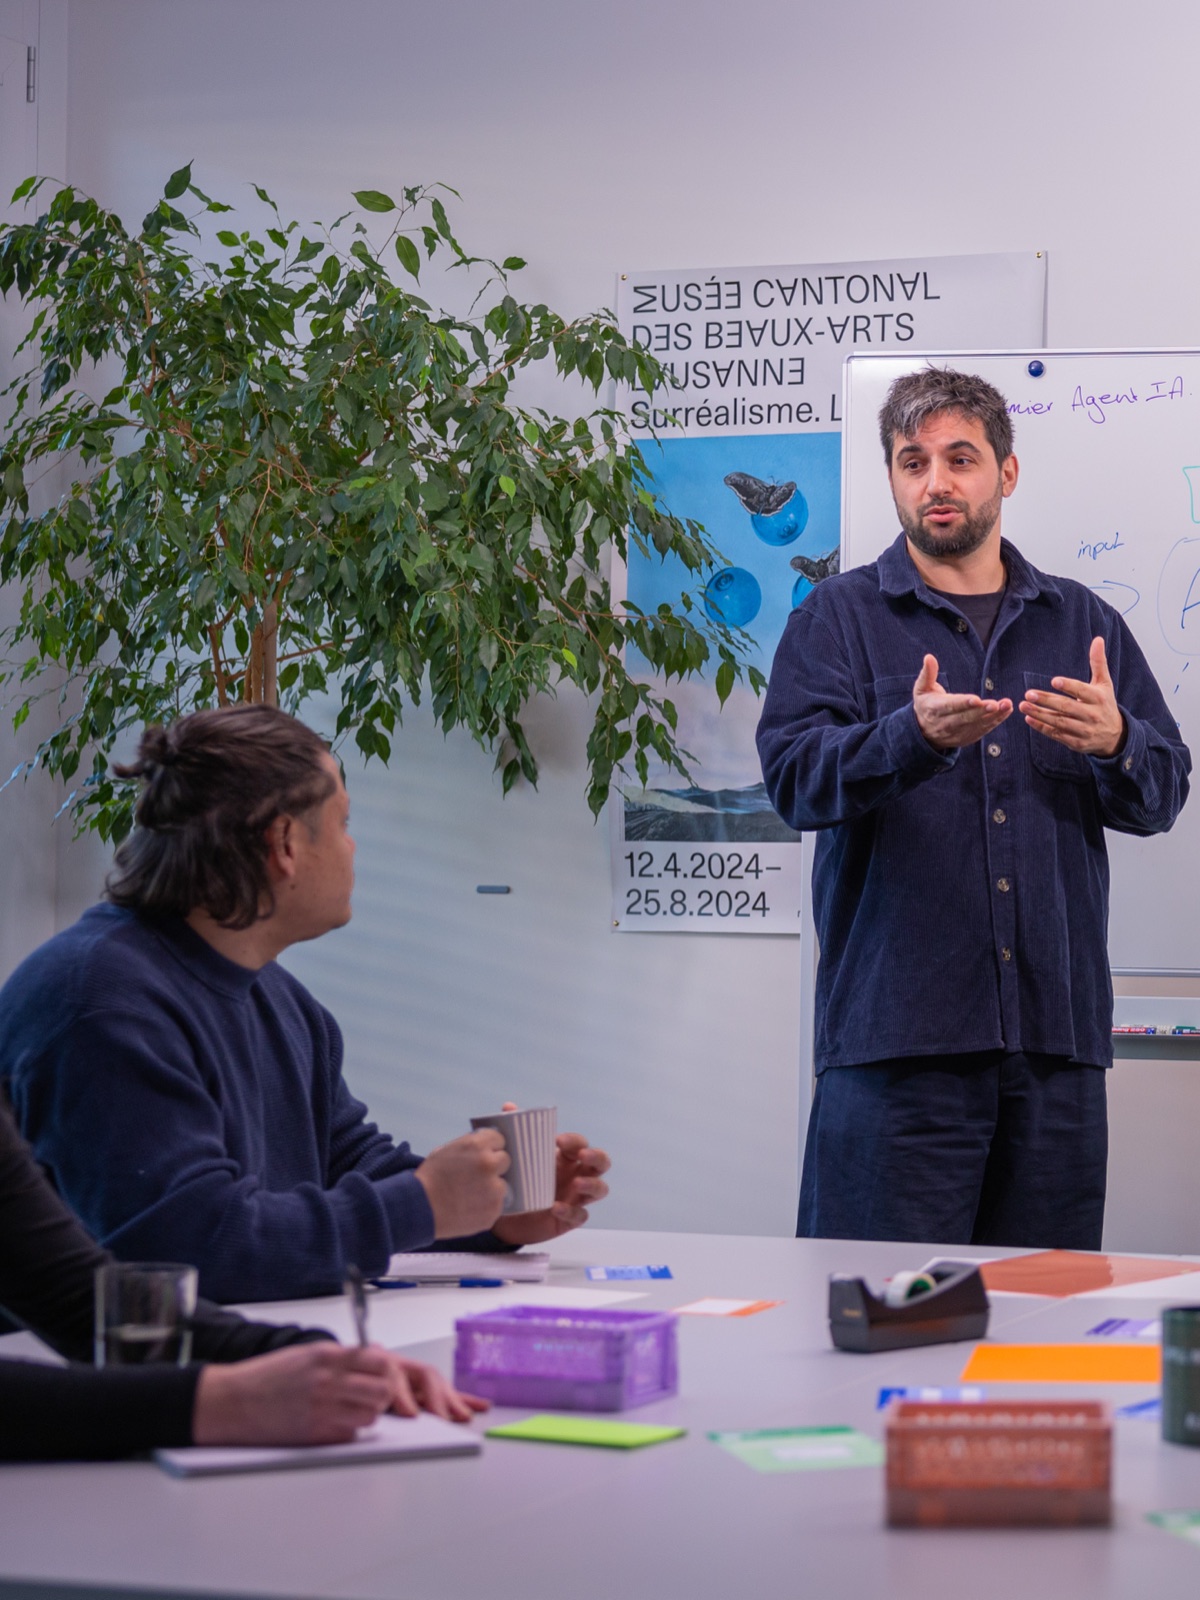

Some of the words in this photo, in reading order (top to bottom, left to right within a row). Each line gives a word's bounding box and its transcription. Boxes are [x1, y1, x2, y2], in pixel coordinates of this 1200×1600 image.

[632, 276, 742, 314] MUSÉE
[752, 272, 942, 308] CANTONAL
[632, 322, 692, 353] DES
[705, 312, 916, 349] BEAUX-ARTS
[630, 397, 820, 430] Surréalisme.
[1072, 386, 1138, 424] Agent
[1077, 531, 1125, 560] input
[625, 888, 771, 918] 25.8.2024
